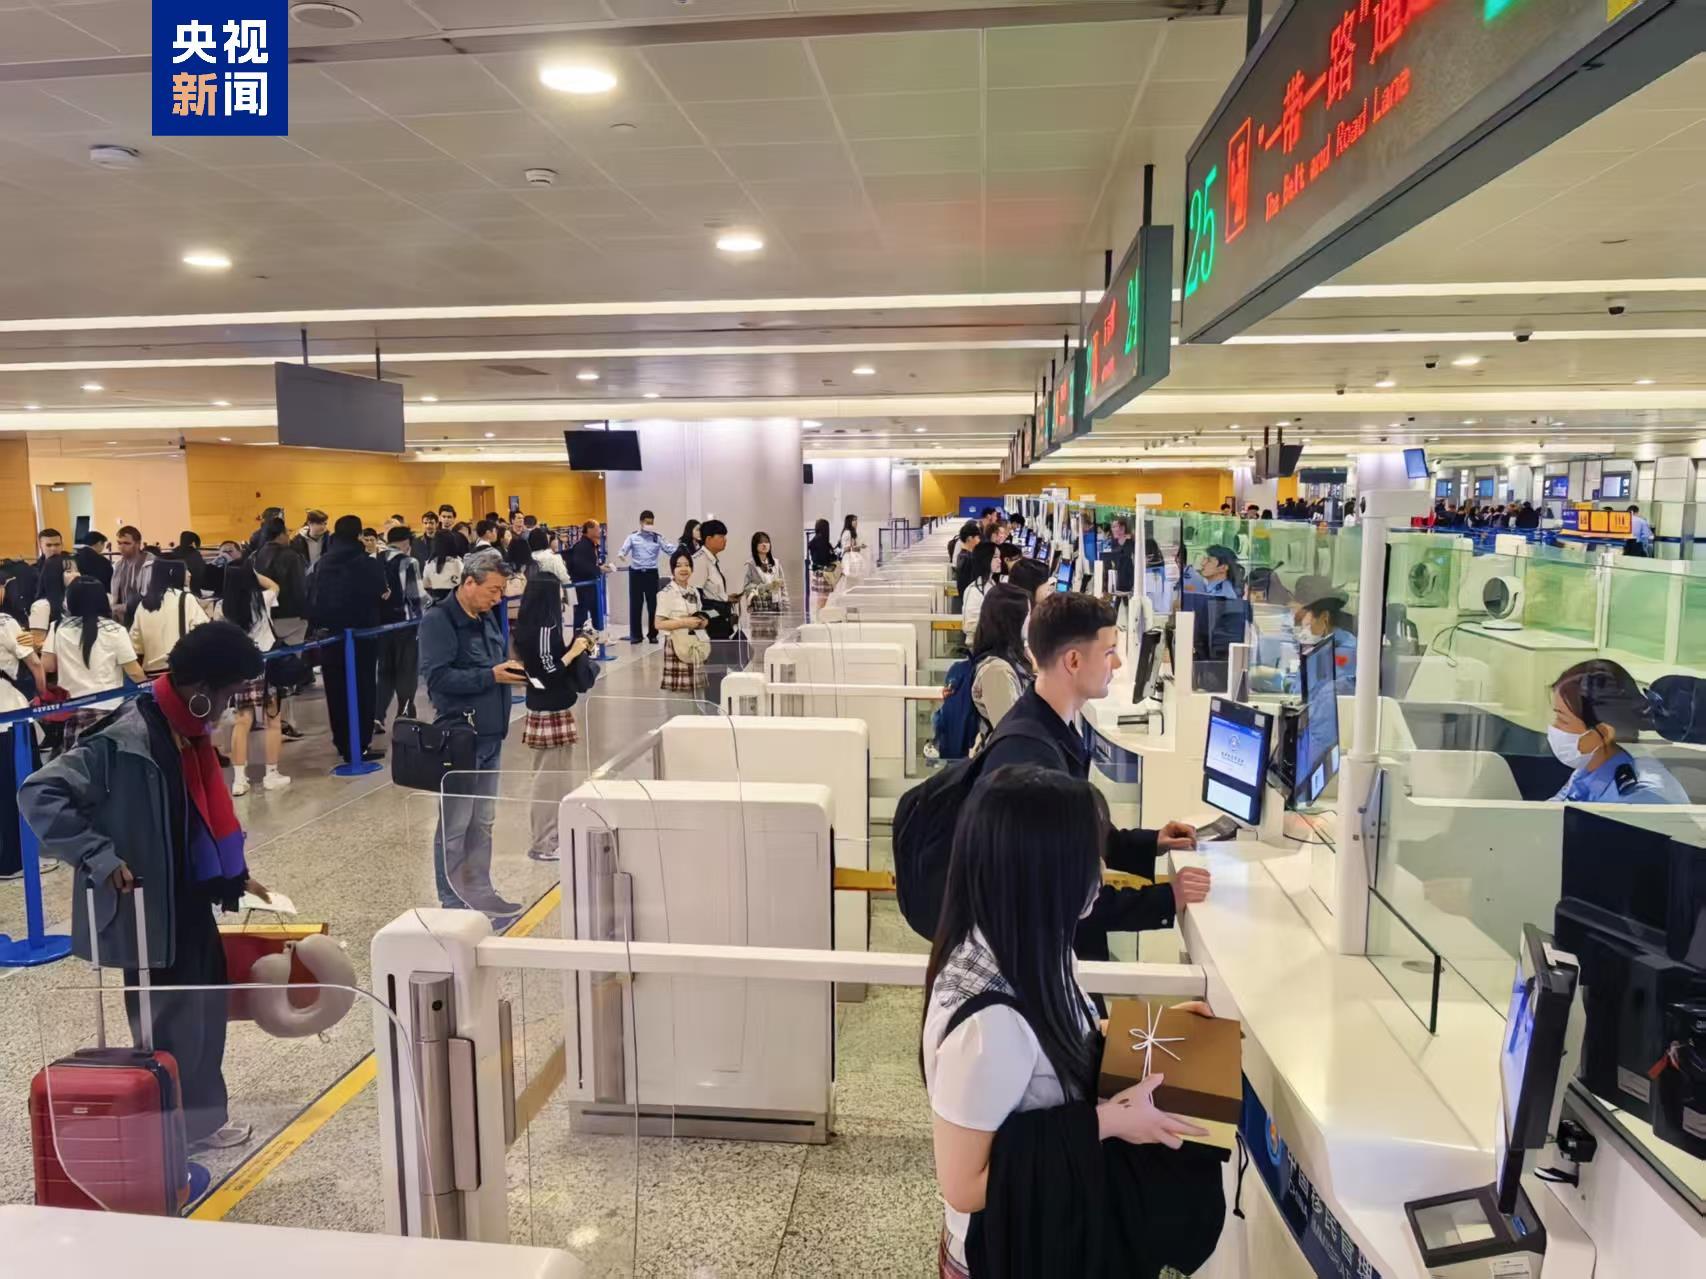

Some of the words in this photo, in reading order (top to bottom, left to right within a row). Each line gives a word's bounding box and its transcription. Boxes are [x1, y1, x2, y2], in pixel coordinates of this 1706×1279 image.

[1310, 133, 1331, 181] and
[1336, 97, 1368, 157] Road
[1372, 67, 1411, 124] Lane
[1184, 164, 1218, 299] 25
